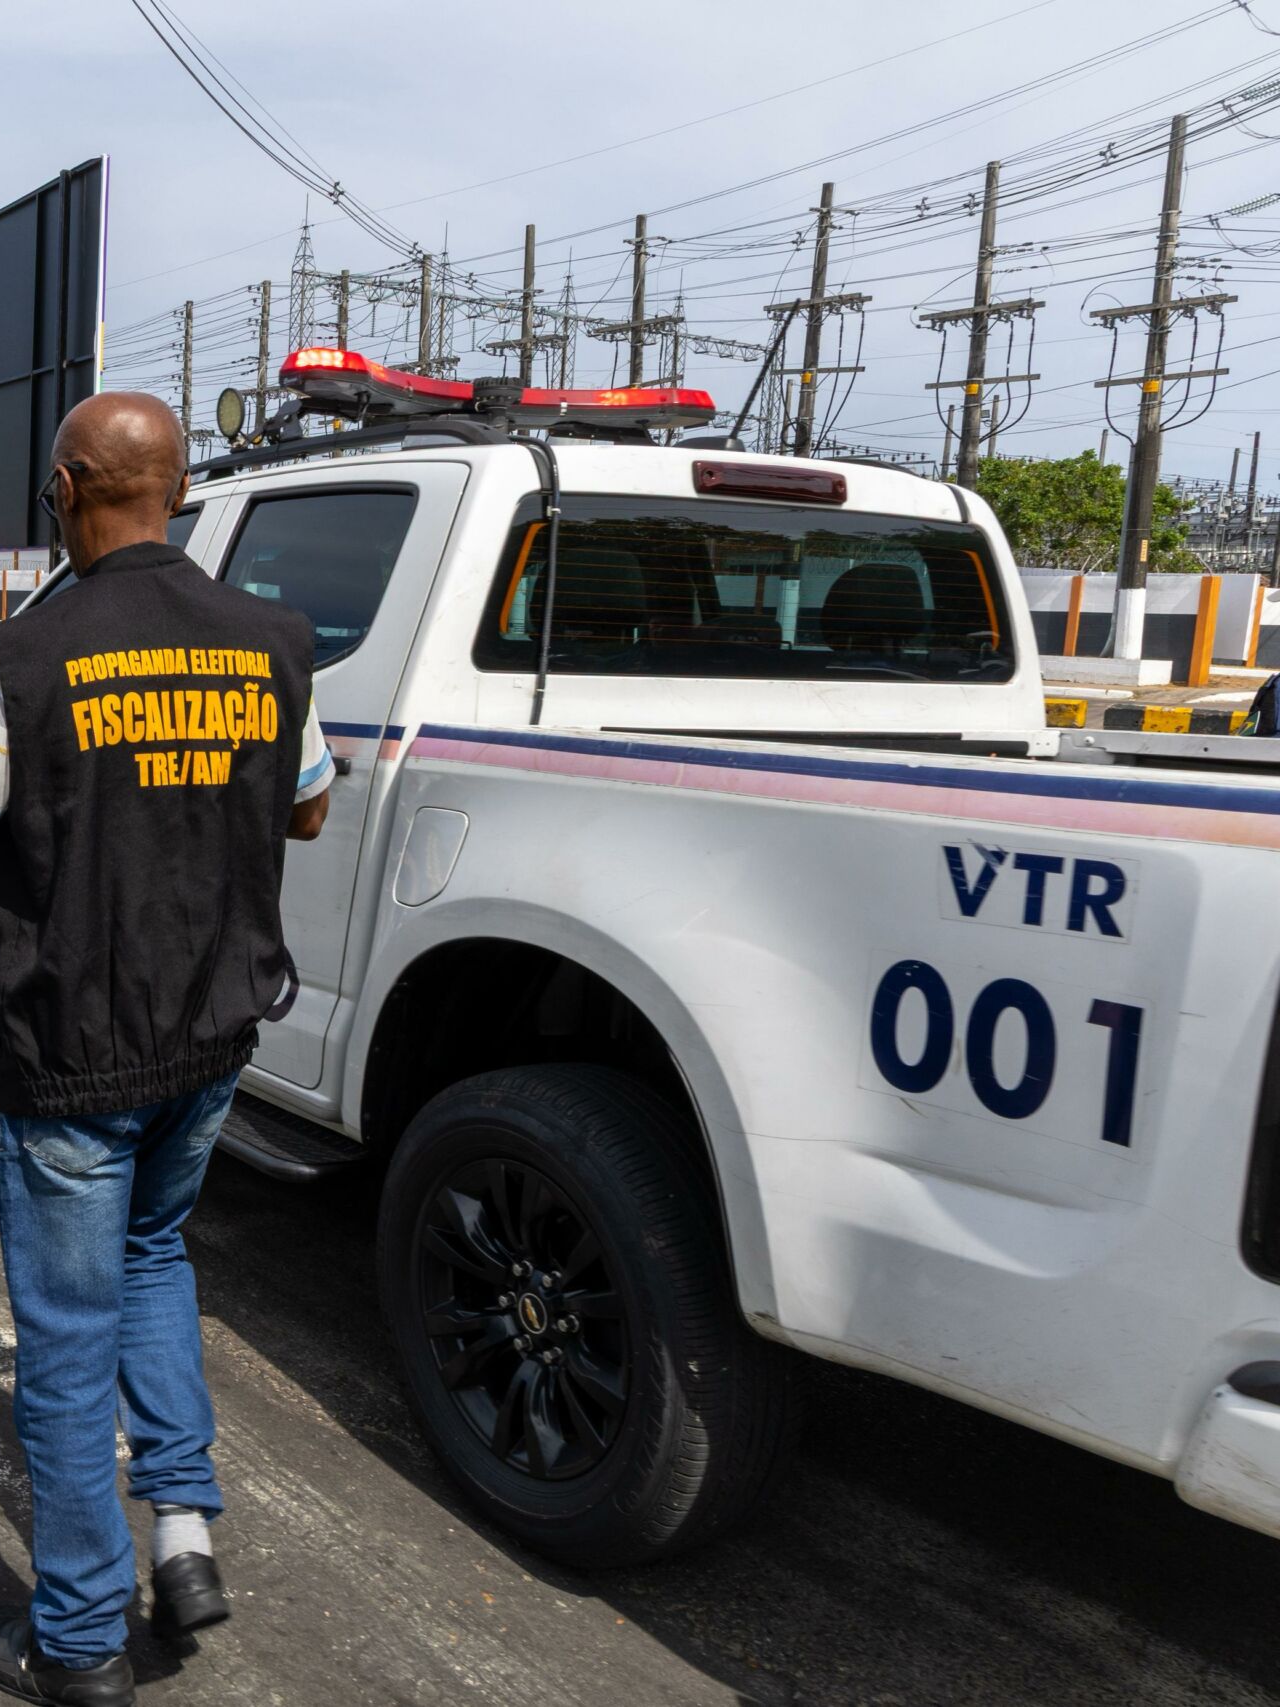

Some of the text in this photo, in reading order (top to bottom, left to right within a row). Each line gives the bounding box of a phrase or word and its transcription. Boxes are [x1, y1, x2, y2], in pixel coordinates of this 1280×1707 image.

[65, 648, 272, 687] PROPAGANDA ELEITORAL
[71, 682, 278, 751] FISCALIZAÇÃO
[134, 751, 232, 787] TRE/AM
[942, 842, 1127, 938] VTR
[870, 959, 1145, 1148] 001
